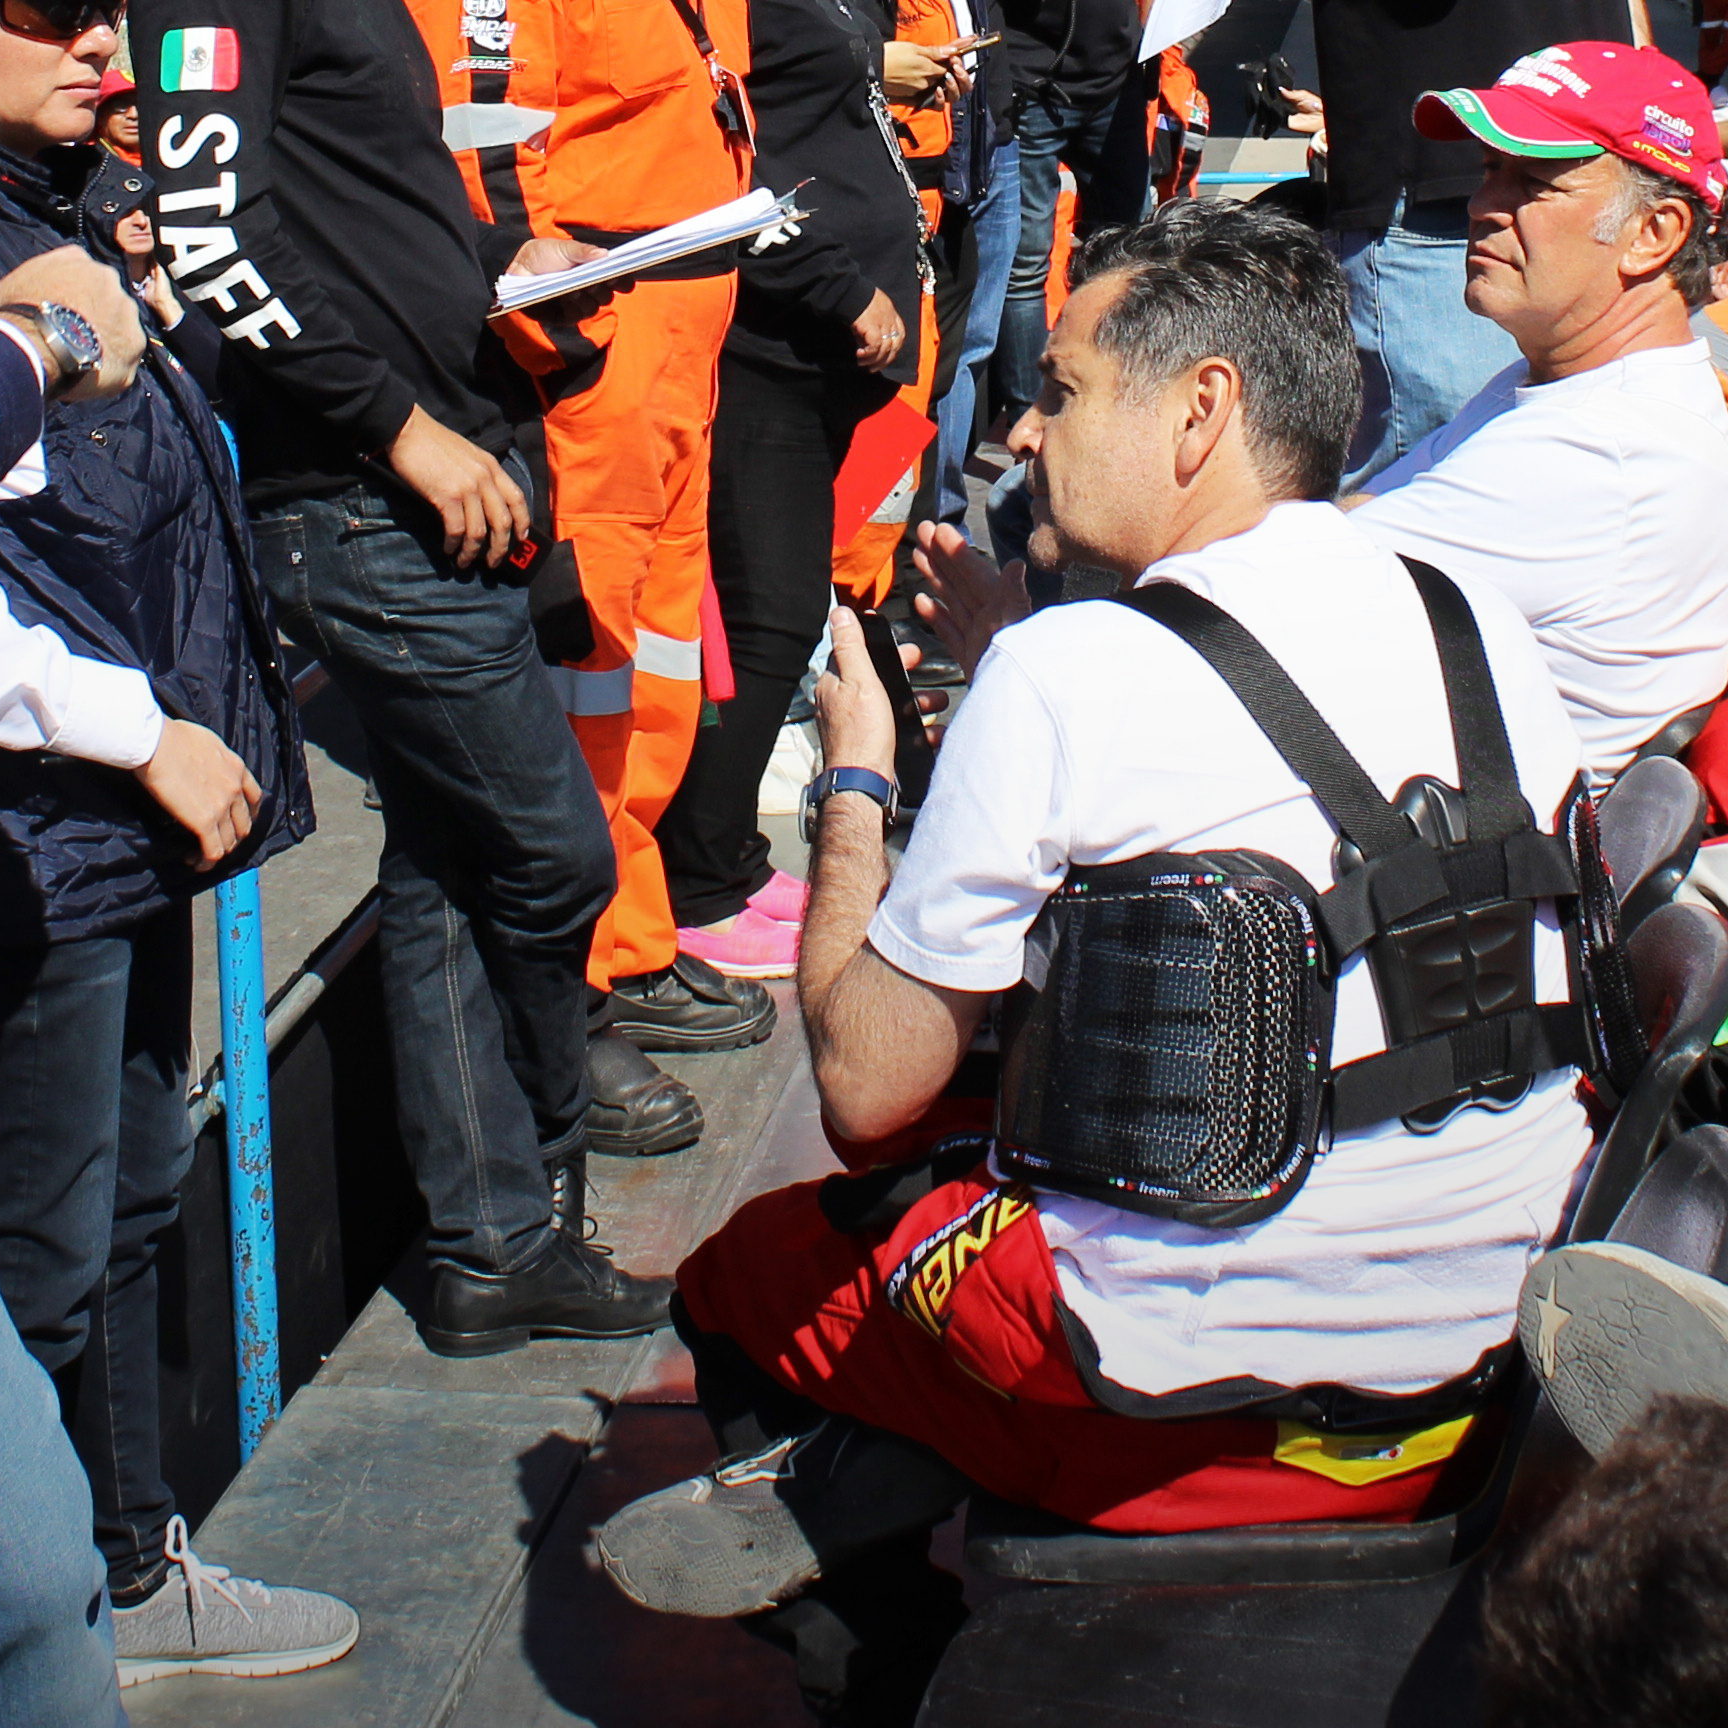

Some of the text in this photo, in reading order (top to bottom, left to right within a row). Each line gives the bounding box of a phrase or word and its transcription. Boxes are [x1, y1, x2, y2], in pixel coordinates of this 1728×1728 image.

[1643, 104, 1695, 138] circuito
[156, 112, 303, 352] STAFF
[1149, 874, 1191, 887] freem
[1278, 1143, 1307, 1184] freem
[1137, 1179, 1180, 1200] freem
